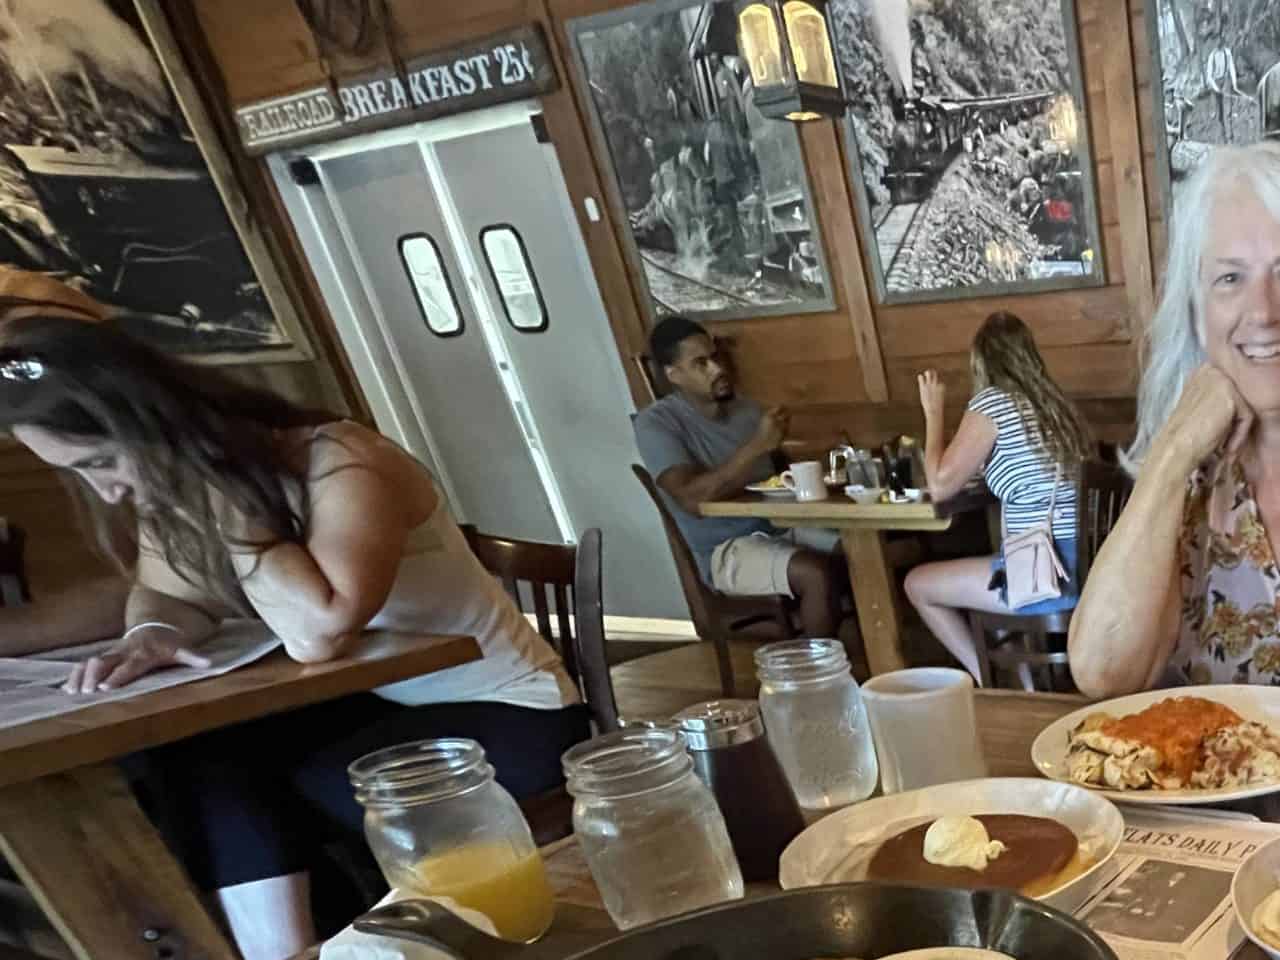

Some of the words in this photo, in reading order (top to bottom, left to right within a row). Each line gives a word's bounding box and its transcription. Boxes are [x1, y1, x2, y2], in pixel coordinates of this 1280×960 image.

[244, 95, 335, 139] RAILROAD
[338, 54, 493, 122] BREAKFAST
[493, 41, 536, 85] 25¢
[1177, 836, 1243, 857] DAILY
